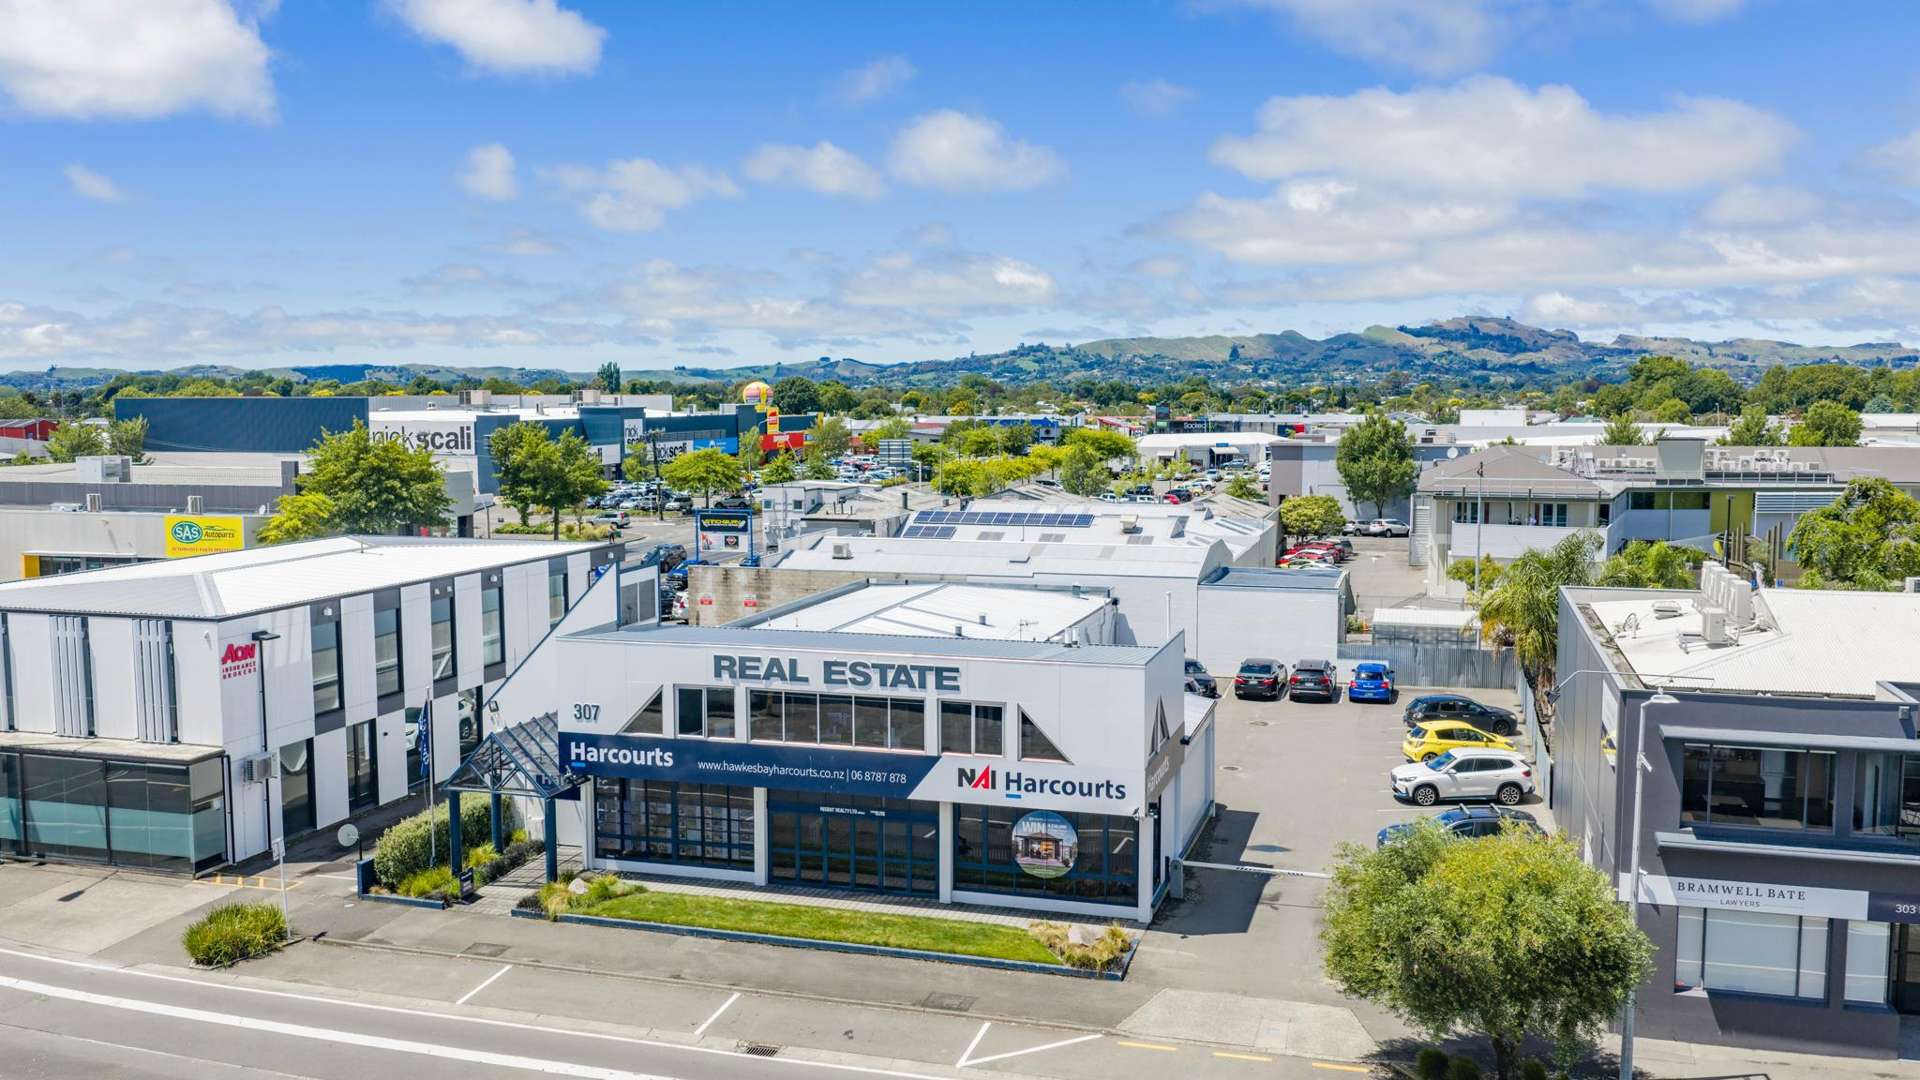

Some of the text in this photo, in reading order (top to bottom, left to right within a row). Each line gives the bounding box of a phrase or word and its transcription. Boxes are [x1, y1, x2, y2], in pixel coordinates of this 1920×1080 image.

[175, 525, 199, 539] SAS
[222, 661, 256, 672] INSURANCE
[222, 667, 256, 679] BROKERS
[713, 655, 961, 691] REAL ESTATE
[573, 704, 600, 720] 307
[570, 742, 674, 767] Harcourts
[697, 760, 907, 784] www.hawkesbayharcourts.co.nz 06 8787 878
[957, 765, 1126, 800] NAI Harcourts
[1022, 821, 1046, 833] WIN
[1677, 882, 1807, 900] BRAMWELL BATE
[1720, 899, 1761, 908] LAWYERS
[1895, 904, 1916, 914] 303
